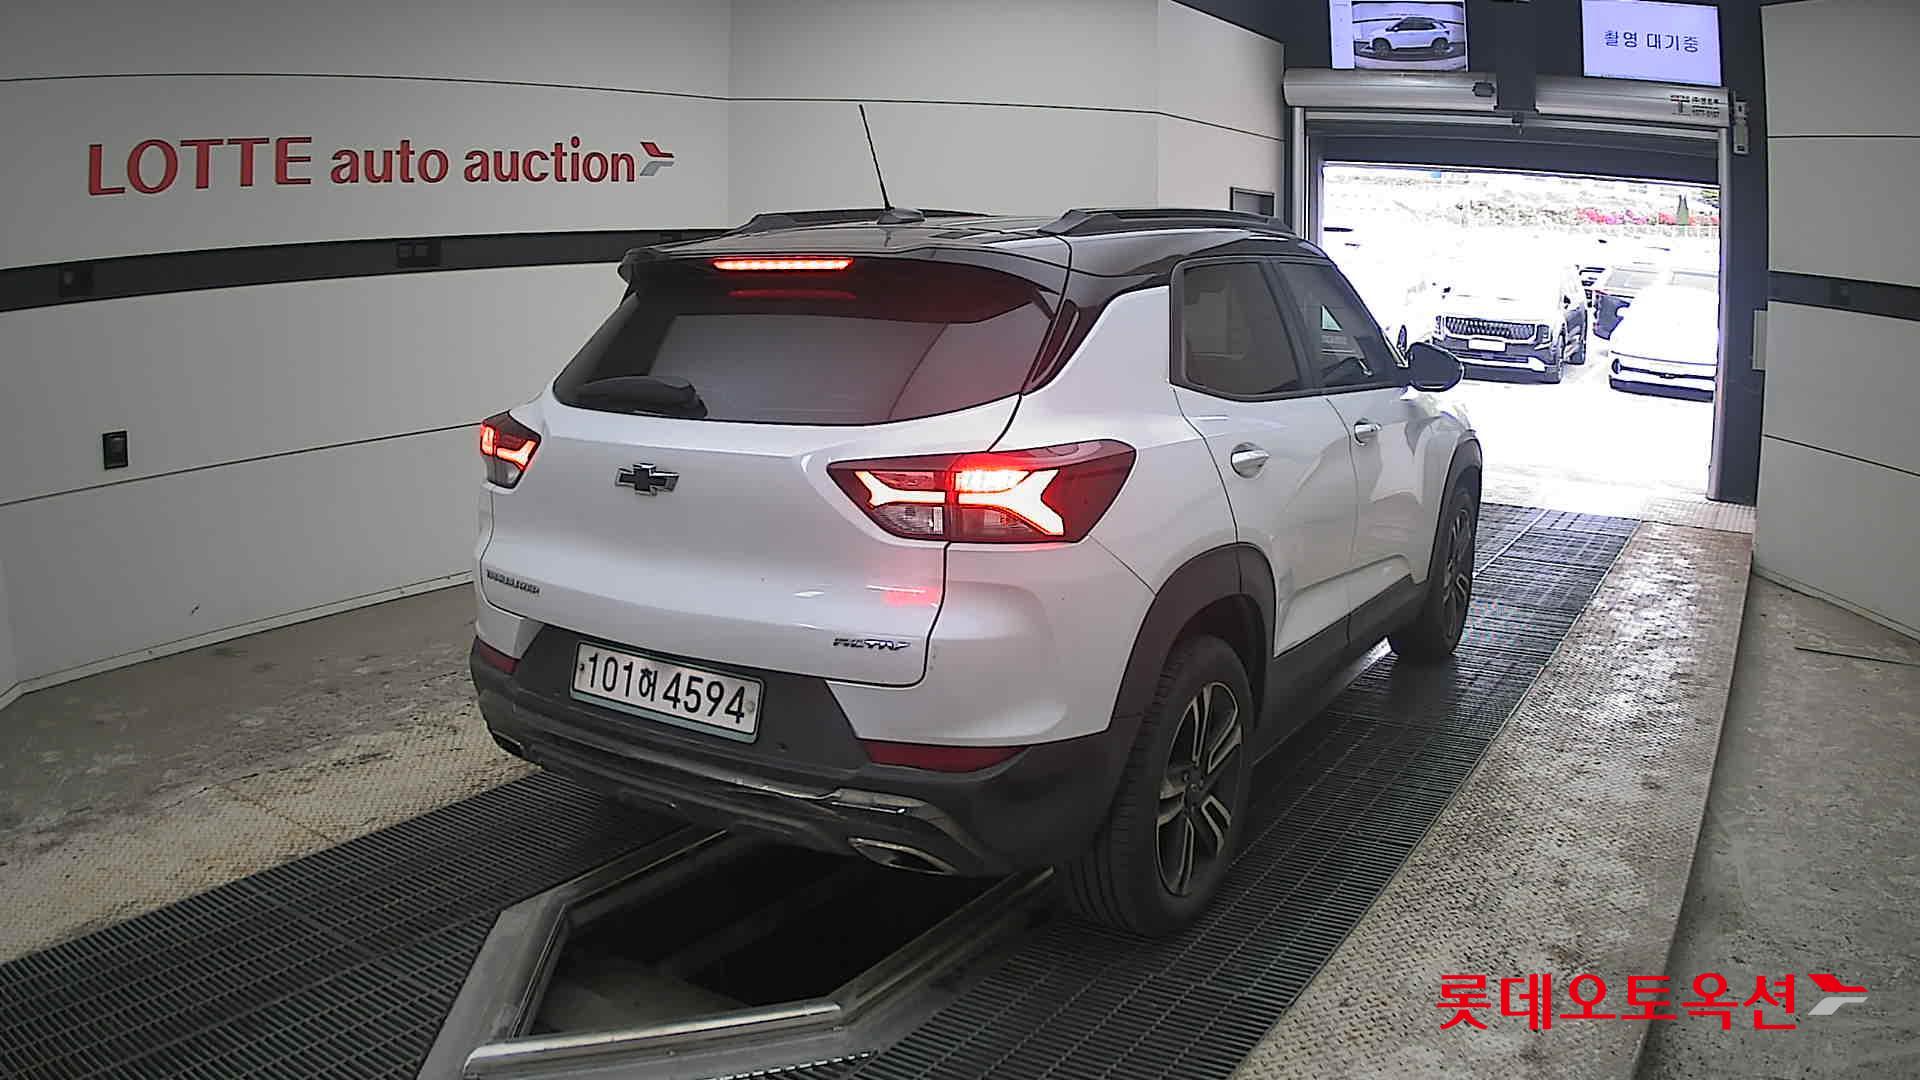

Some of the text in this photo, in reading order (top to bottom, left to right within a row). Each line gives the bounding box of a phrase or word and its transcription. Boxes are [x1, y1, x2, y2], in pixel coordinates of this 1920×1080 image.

[1646, 33, 1698, 53] 대기중
[88, 135, 636, 196] LOTTE auto auction
[588, 652, 745, 724] 101허4594
